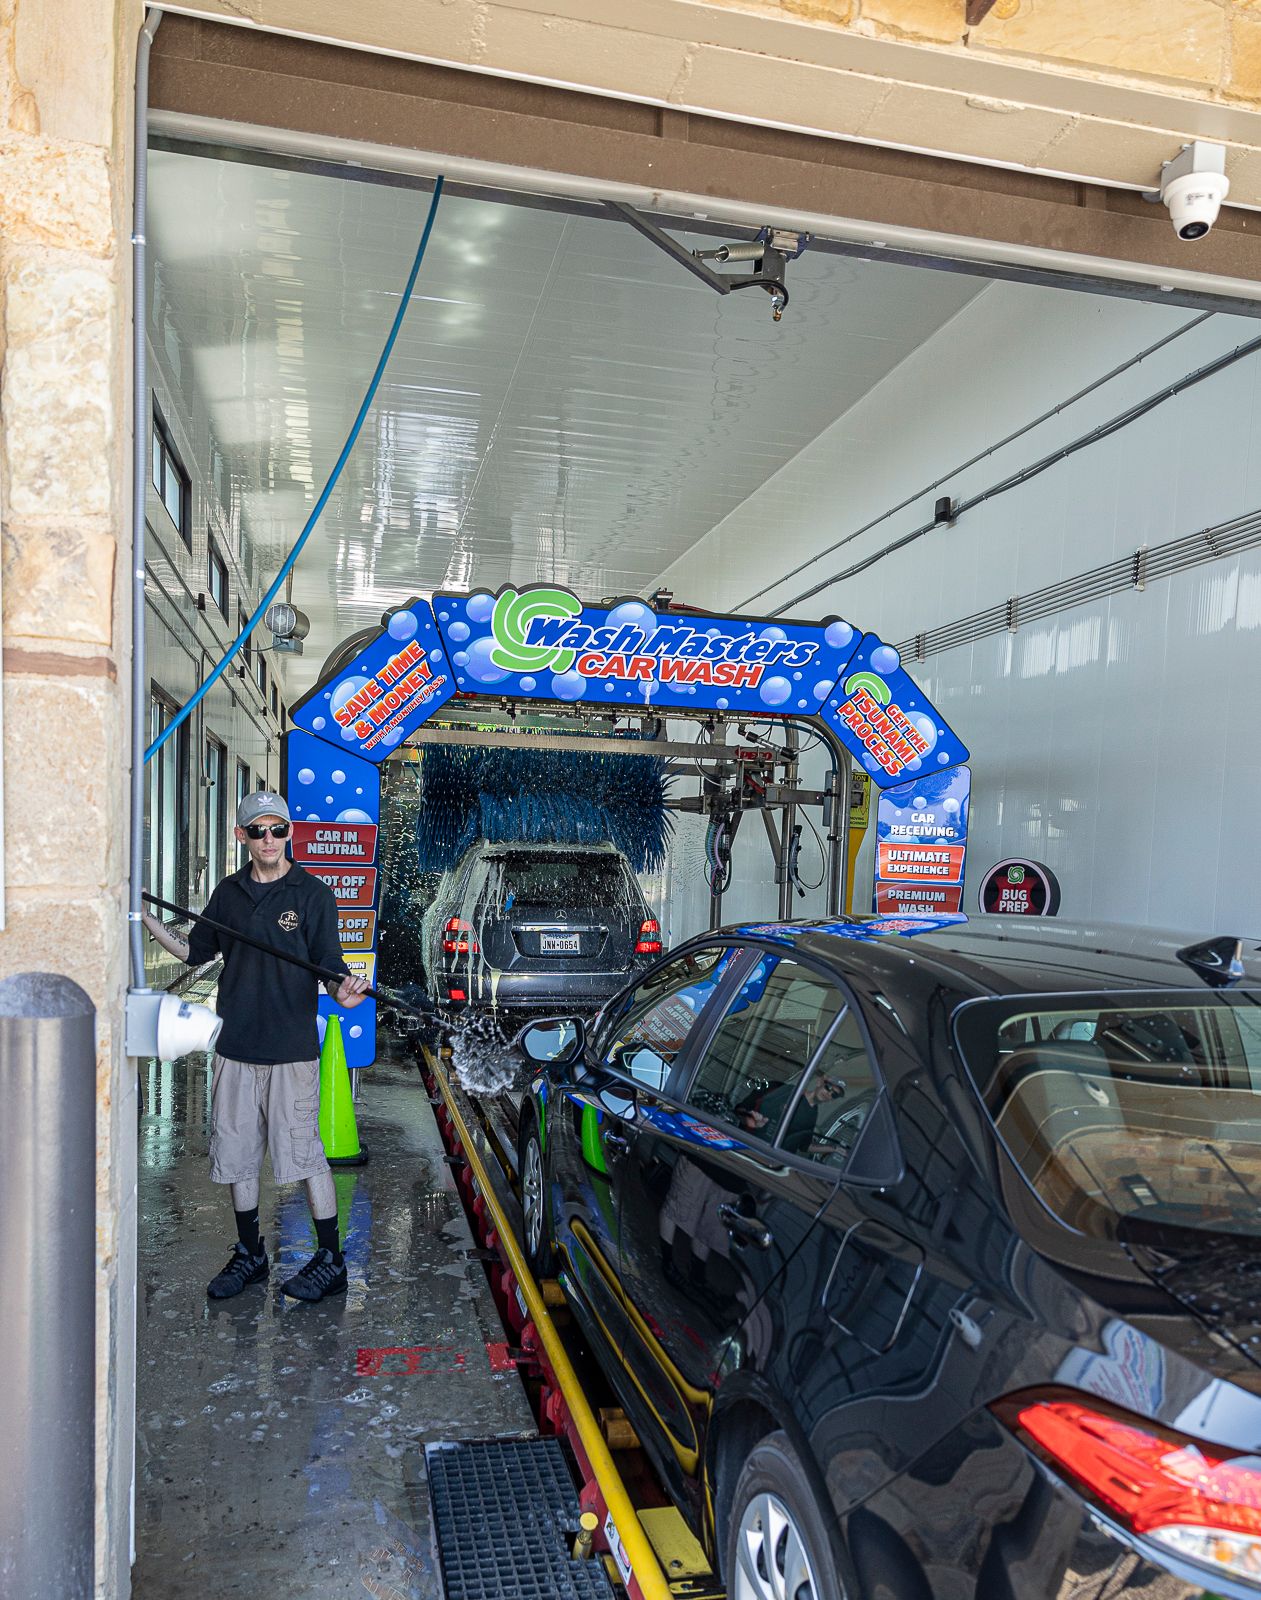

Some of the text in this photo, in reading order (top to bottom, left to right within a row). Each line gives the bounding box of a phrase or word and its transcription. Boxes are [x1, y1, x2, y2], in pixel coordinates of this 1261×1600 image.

[523, 616, 819, 667] Wash Masters
[577, 654, 766, 688] CAR WASH
[334, 639, 426, 727] SAVE TIME
[354, 659, 433, 739] & MONEY
[364, 676, 445, 750] WITH A MONTHLY PASS
[852, 687, 919, 766] TSUNAMI
[886, 704, 931, 754] GET THE
[837, 701, 905, 776] PROCESS
[911, 813, 935, 824] CAR
[315, 830, 358, 843] CAR IN
[890, 825, 954, 837] RECEIVING
[307, 843, 366, 856] NEUTRAL
[887, 850, 951, 863] ULTIMATE
[887, 864, 949, 875] EXPERIENCE
[342, 875, 366, 887] OFF
[333, 888, 359, 899] AKE
[887, 889, 946, 902] PREMIUM
[1002, 889, 1027, 901] BUG
[898, 903, 935, 914] WASH
[999, 901, 1029, 913] PREP
[346, 918, 369, 929] OFF
